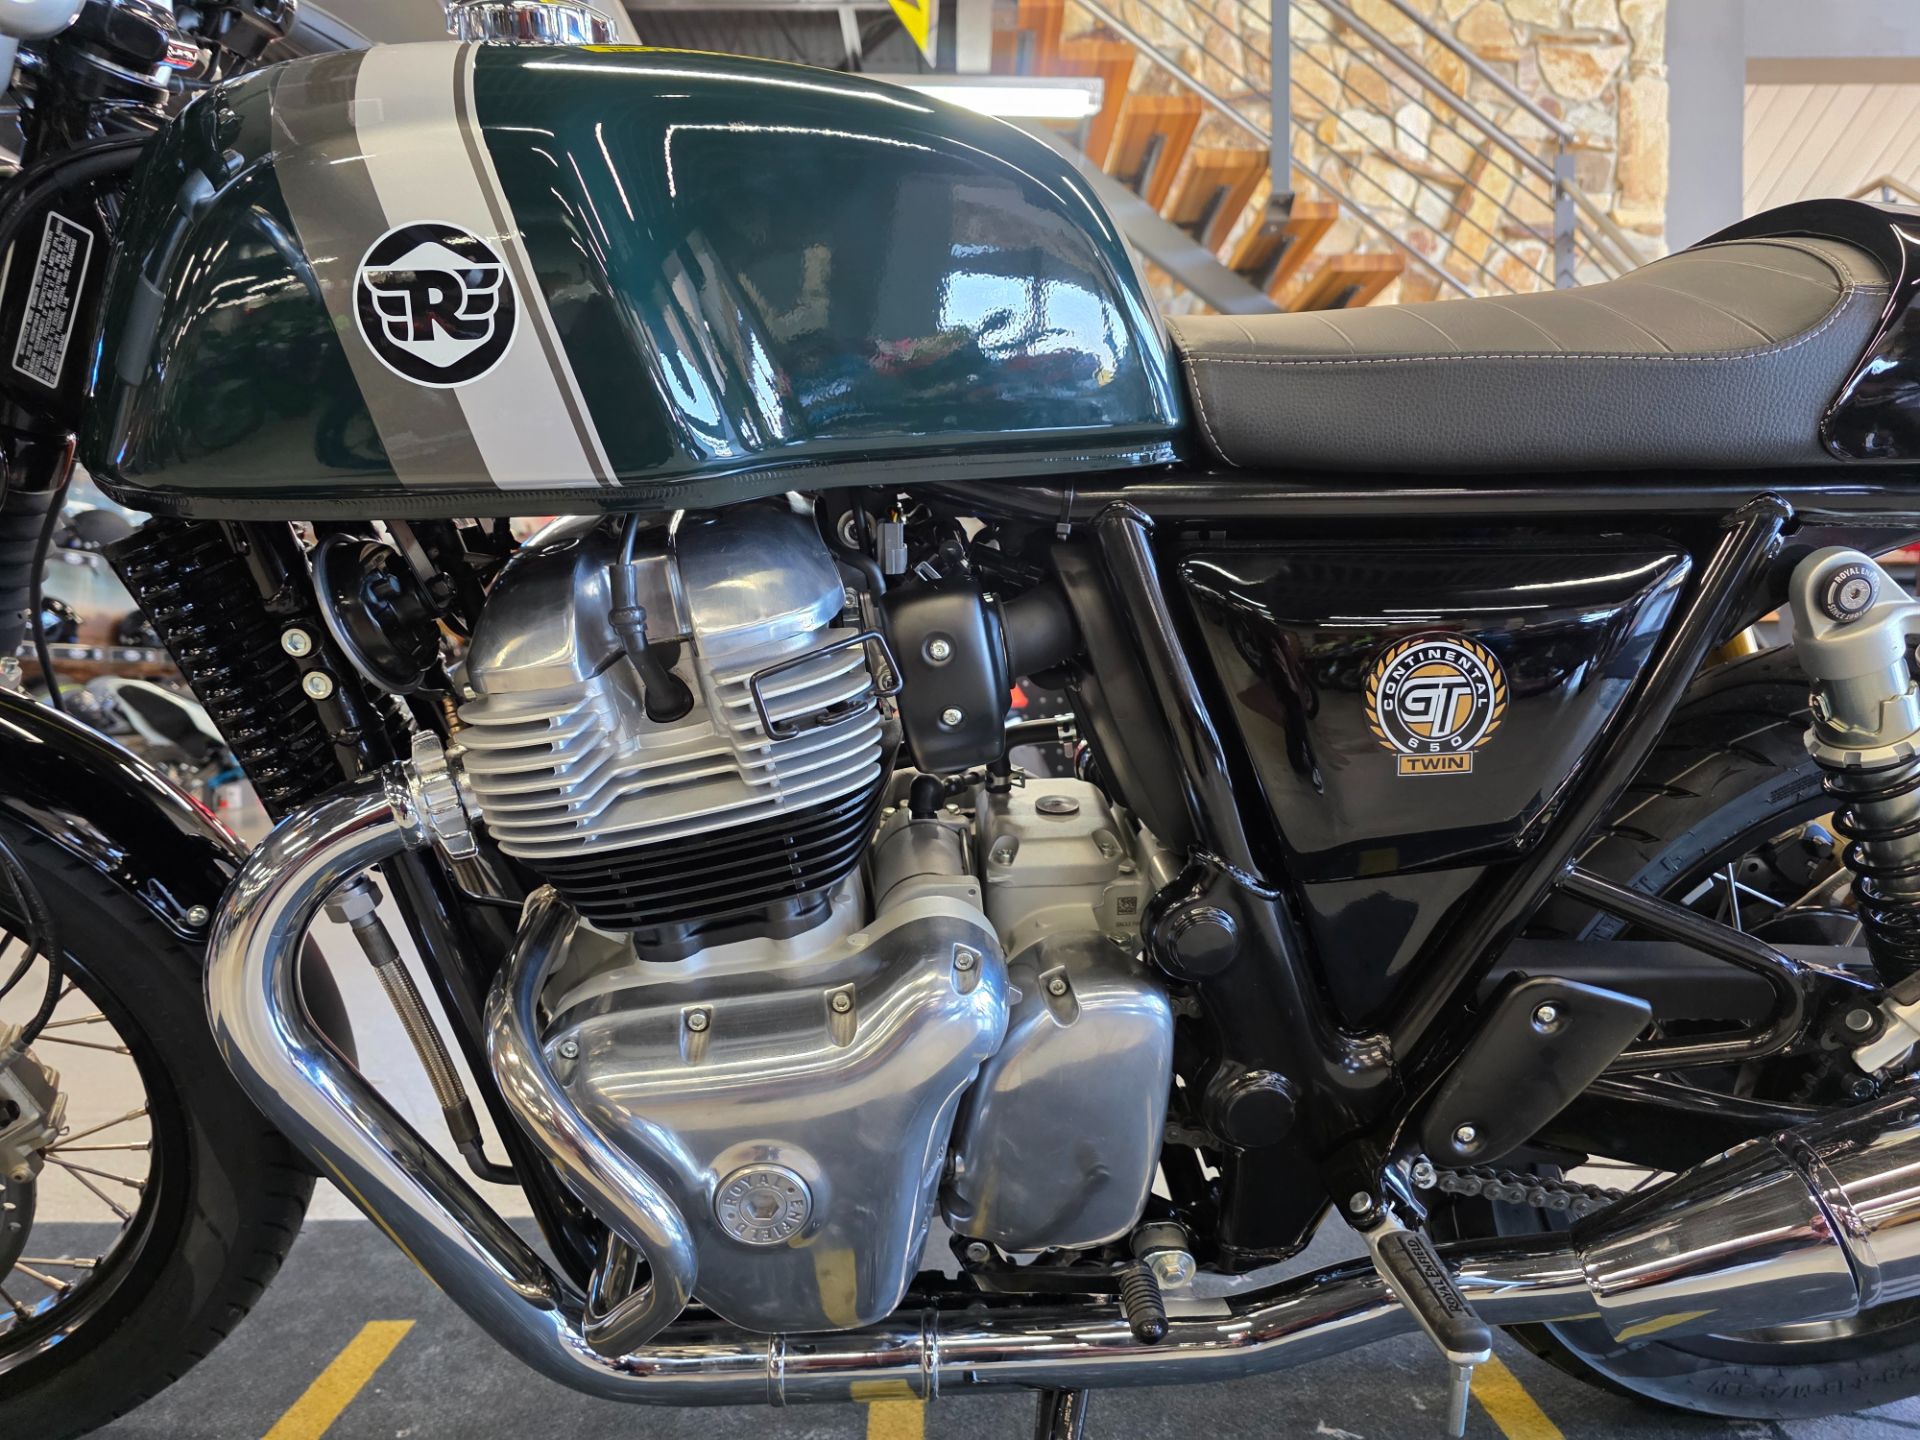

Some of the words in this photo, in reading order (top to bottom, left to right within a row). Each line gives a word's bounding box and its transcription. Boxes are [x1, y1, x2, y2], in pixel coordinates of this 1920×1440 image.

[1834, 567, 1860, 584] ROYAL
[1383, 649, 1489, 711] CONTINENTAL
[1399, 676, 1472, 738] GT
[1408, 736, 1462, 752] 650
[1407, 756, 1464, 771] TWIN
[723, 1174, 782, 1209] ROYAL
[734, 1199, 804, 1242] ENFIELD
[1407, 1239, 1440, 1278] ENFIELD
[1434, 1277, 1463, 1313] ROYAL
